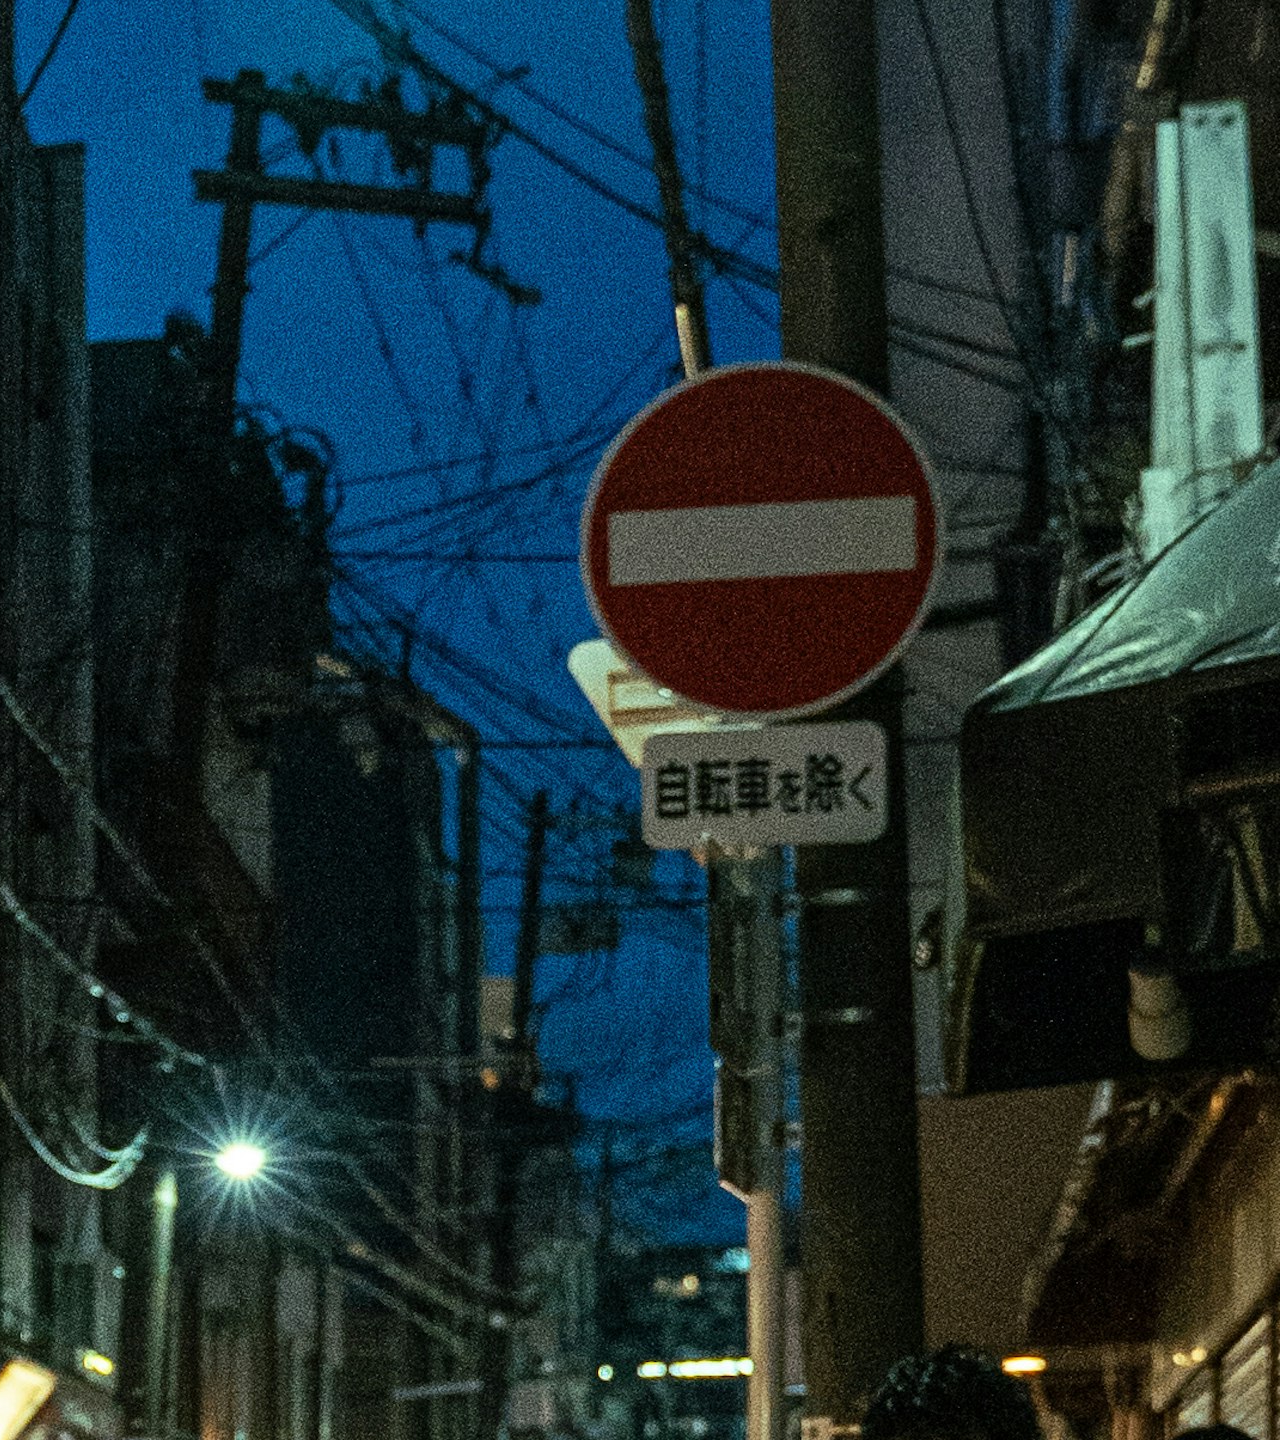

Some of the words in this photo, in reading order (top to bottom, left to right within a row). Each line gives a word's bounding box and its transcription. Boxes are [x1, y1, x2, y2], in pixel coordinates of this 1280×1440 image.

[656, 754, 875, 820] 自転車を除く
